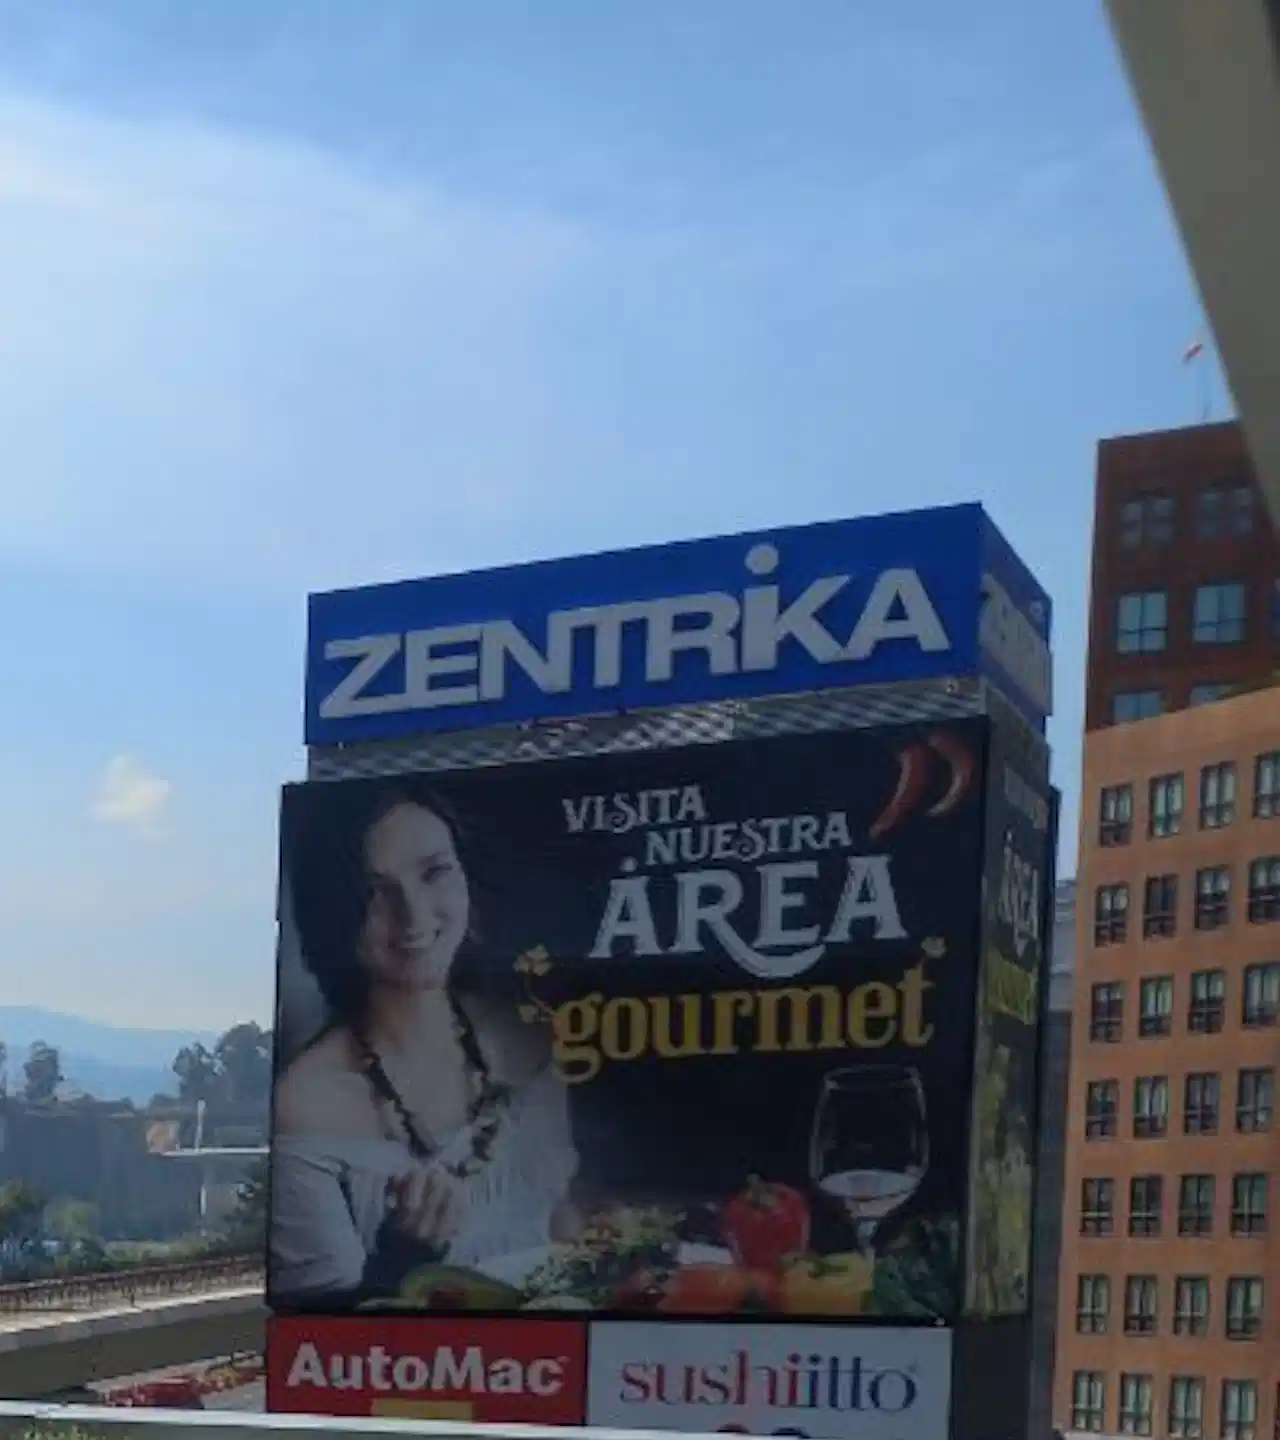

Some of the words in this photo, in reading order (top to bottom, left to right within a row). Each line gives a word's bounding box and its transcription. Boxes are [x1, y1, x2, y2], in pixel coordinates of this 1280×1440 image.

[562, 785, 708, 834] VISITA
[646, 811, 852, 866] NUESTRA
[587, 855, 909, 979] ÁREA
[550, 961, 937, 1084] gourmet
[286, 1341, 566, 1396] AutoMac
[617, 1349, 919, 1413] sushiitto
